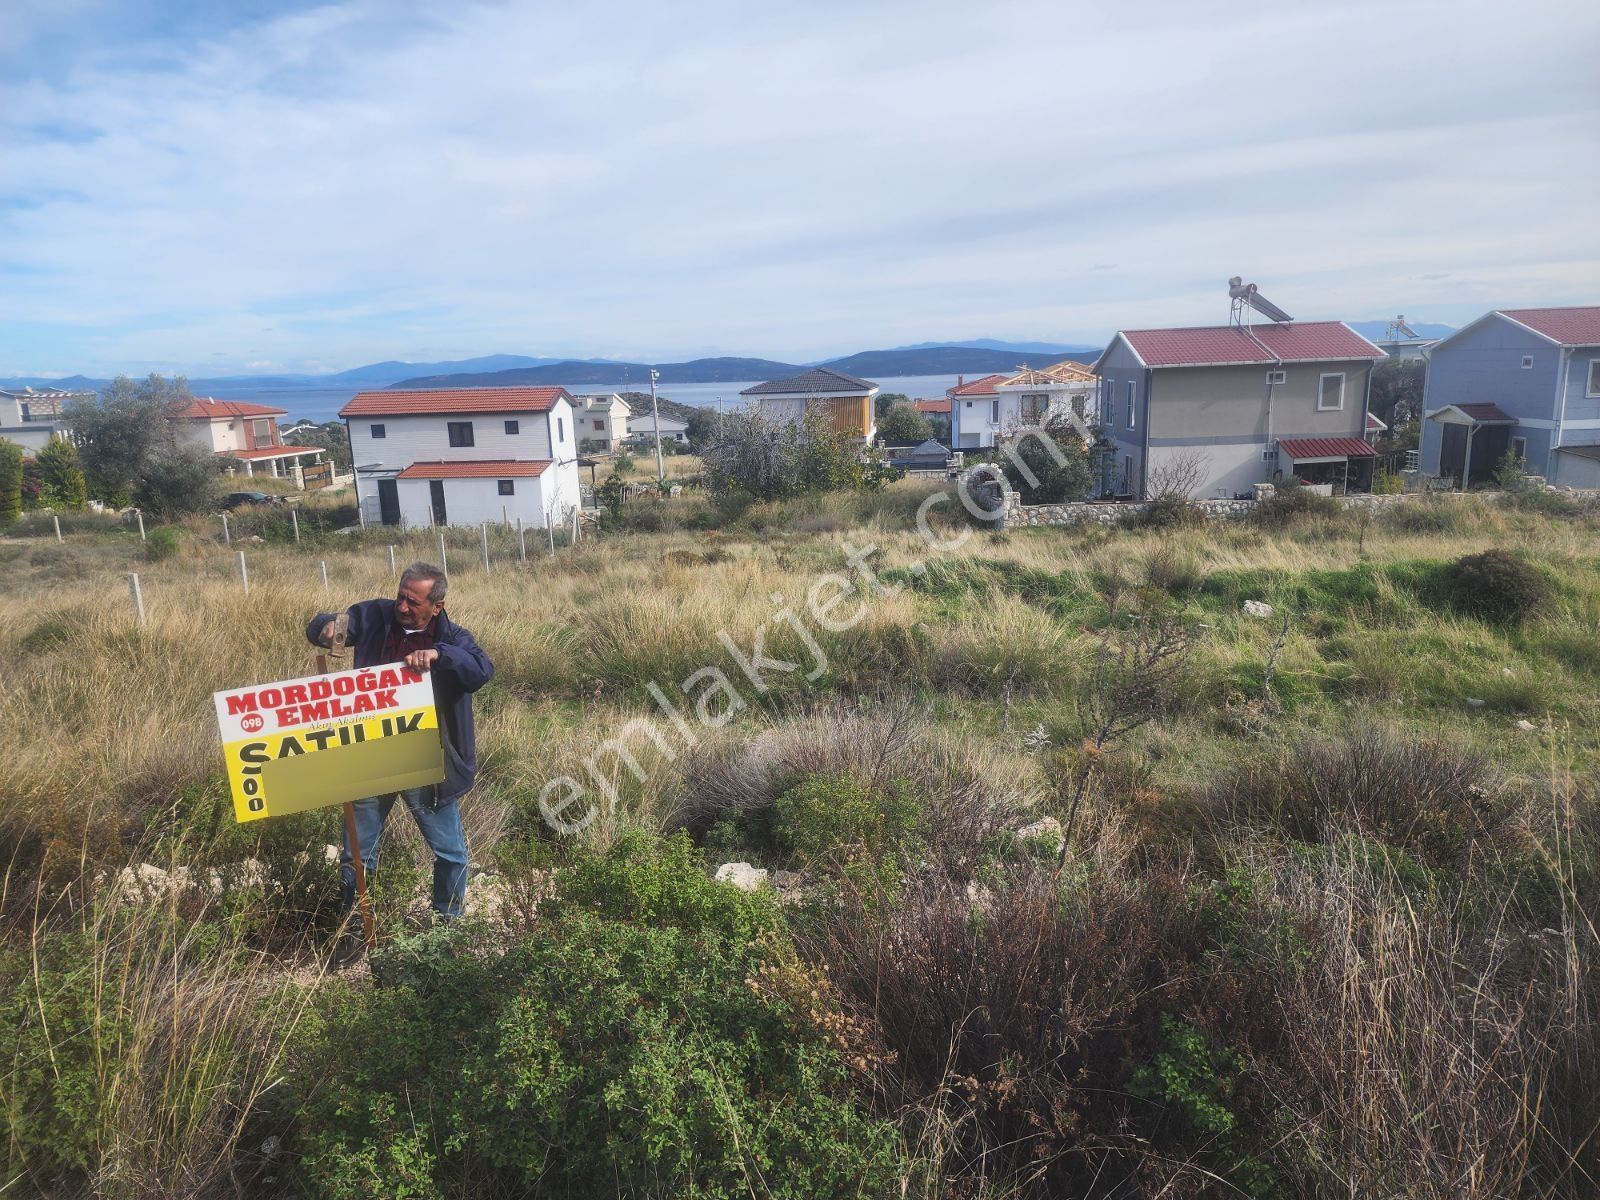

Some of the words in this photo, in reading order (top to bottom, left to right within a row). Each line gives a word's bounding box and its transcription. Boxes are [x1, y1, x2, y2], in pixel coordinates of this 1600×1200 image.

[225, 667, 423, 715] MORDOĞAN
[276, 689, 399, 727] EMLAK
[242, 717, 262, 730] 098
